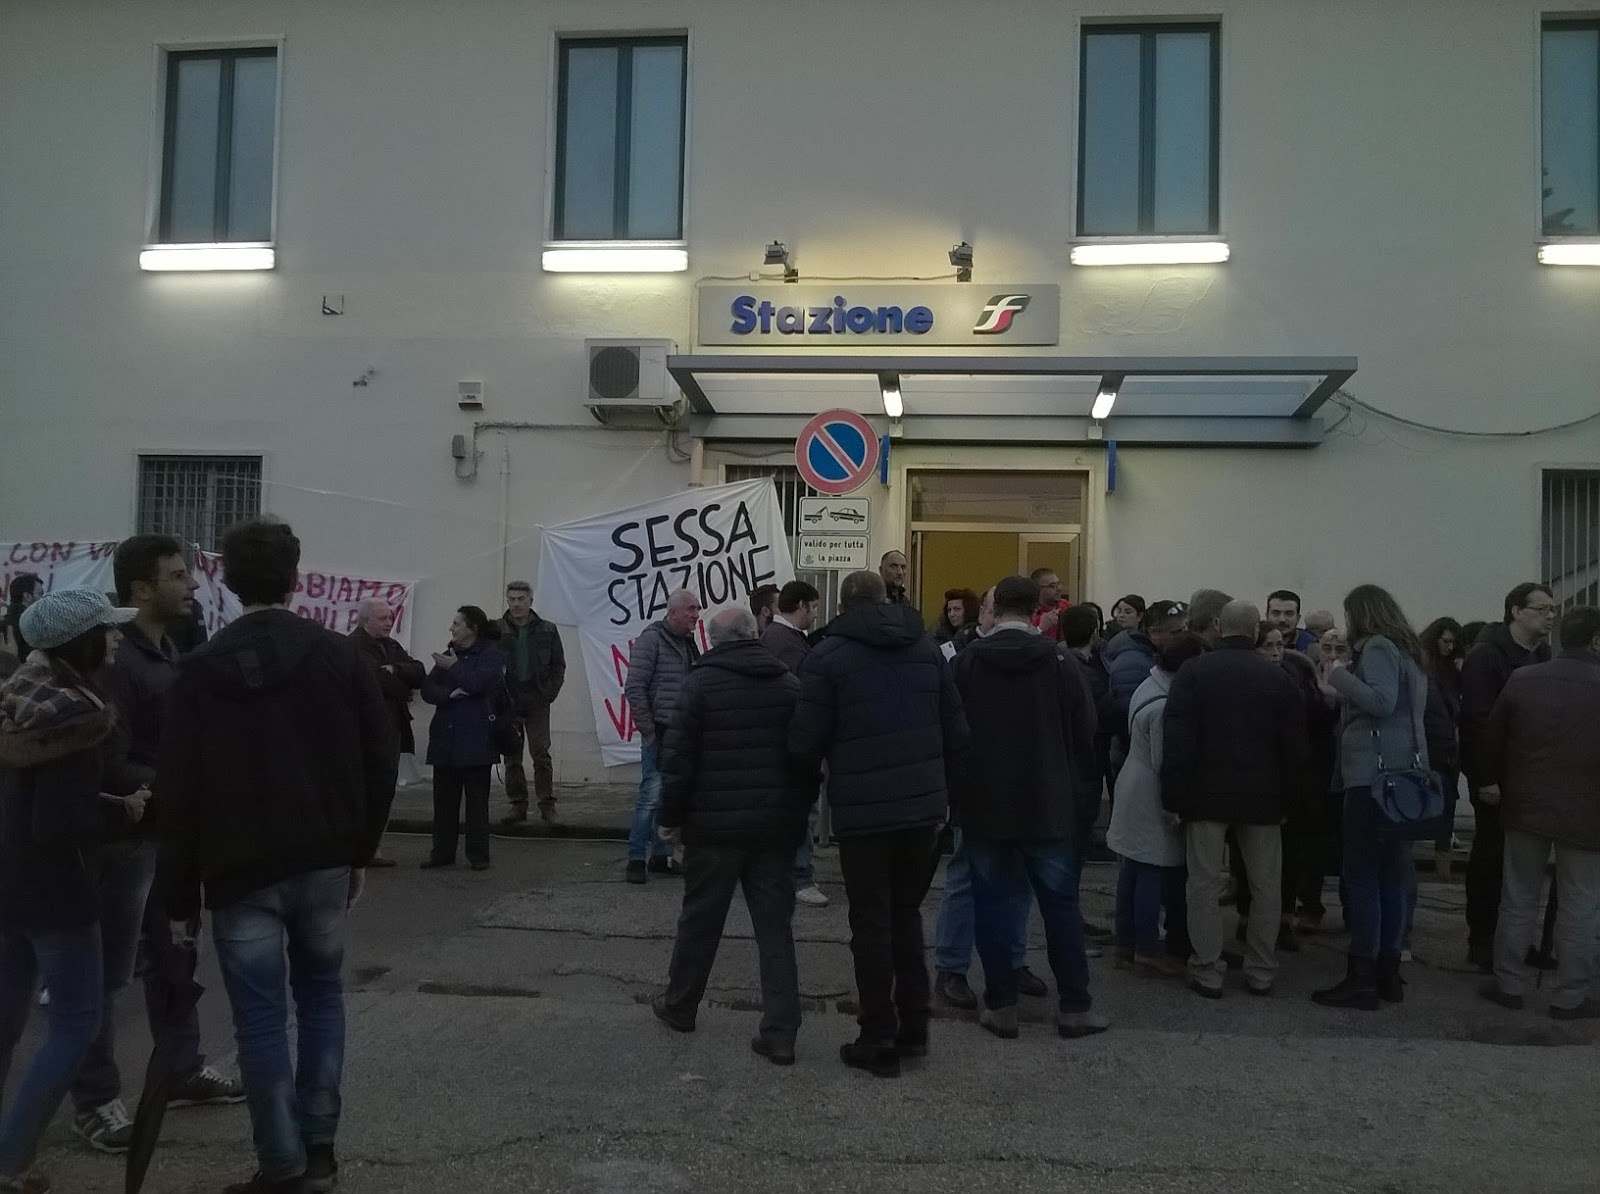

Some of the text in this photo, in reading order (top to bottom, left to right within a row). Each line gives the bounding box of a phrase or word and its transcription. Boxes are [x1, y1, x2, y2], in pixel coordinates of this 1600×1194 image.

[730, 295, 934, 336] Stazione
[608, 500, 757, 573] SESSA
[804, 539, 864, 550] valido per tutta
[818, 554, 851, 563] la piazza
[608, 544, 776, 626] STAZIONE
